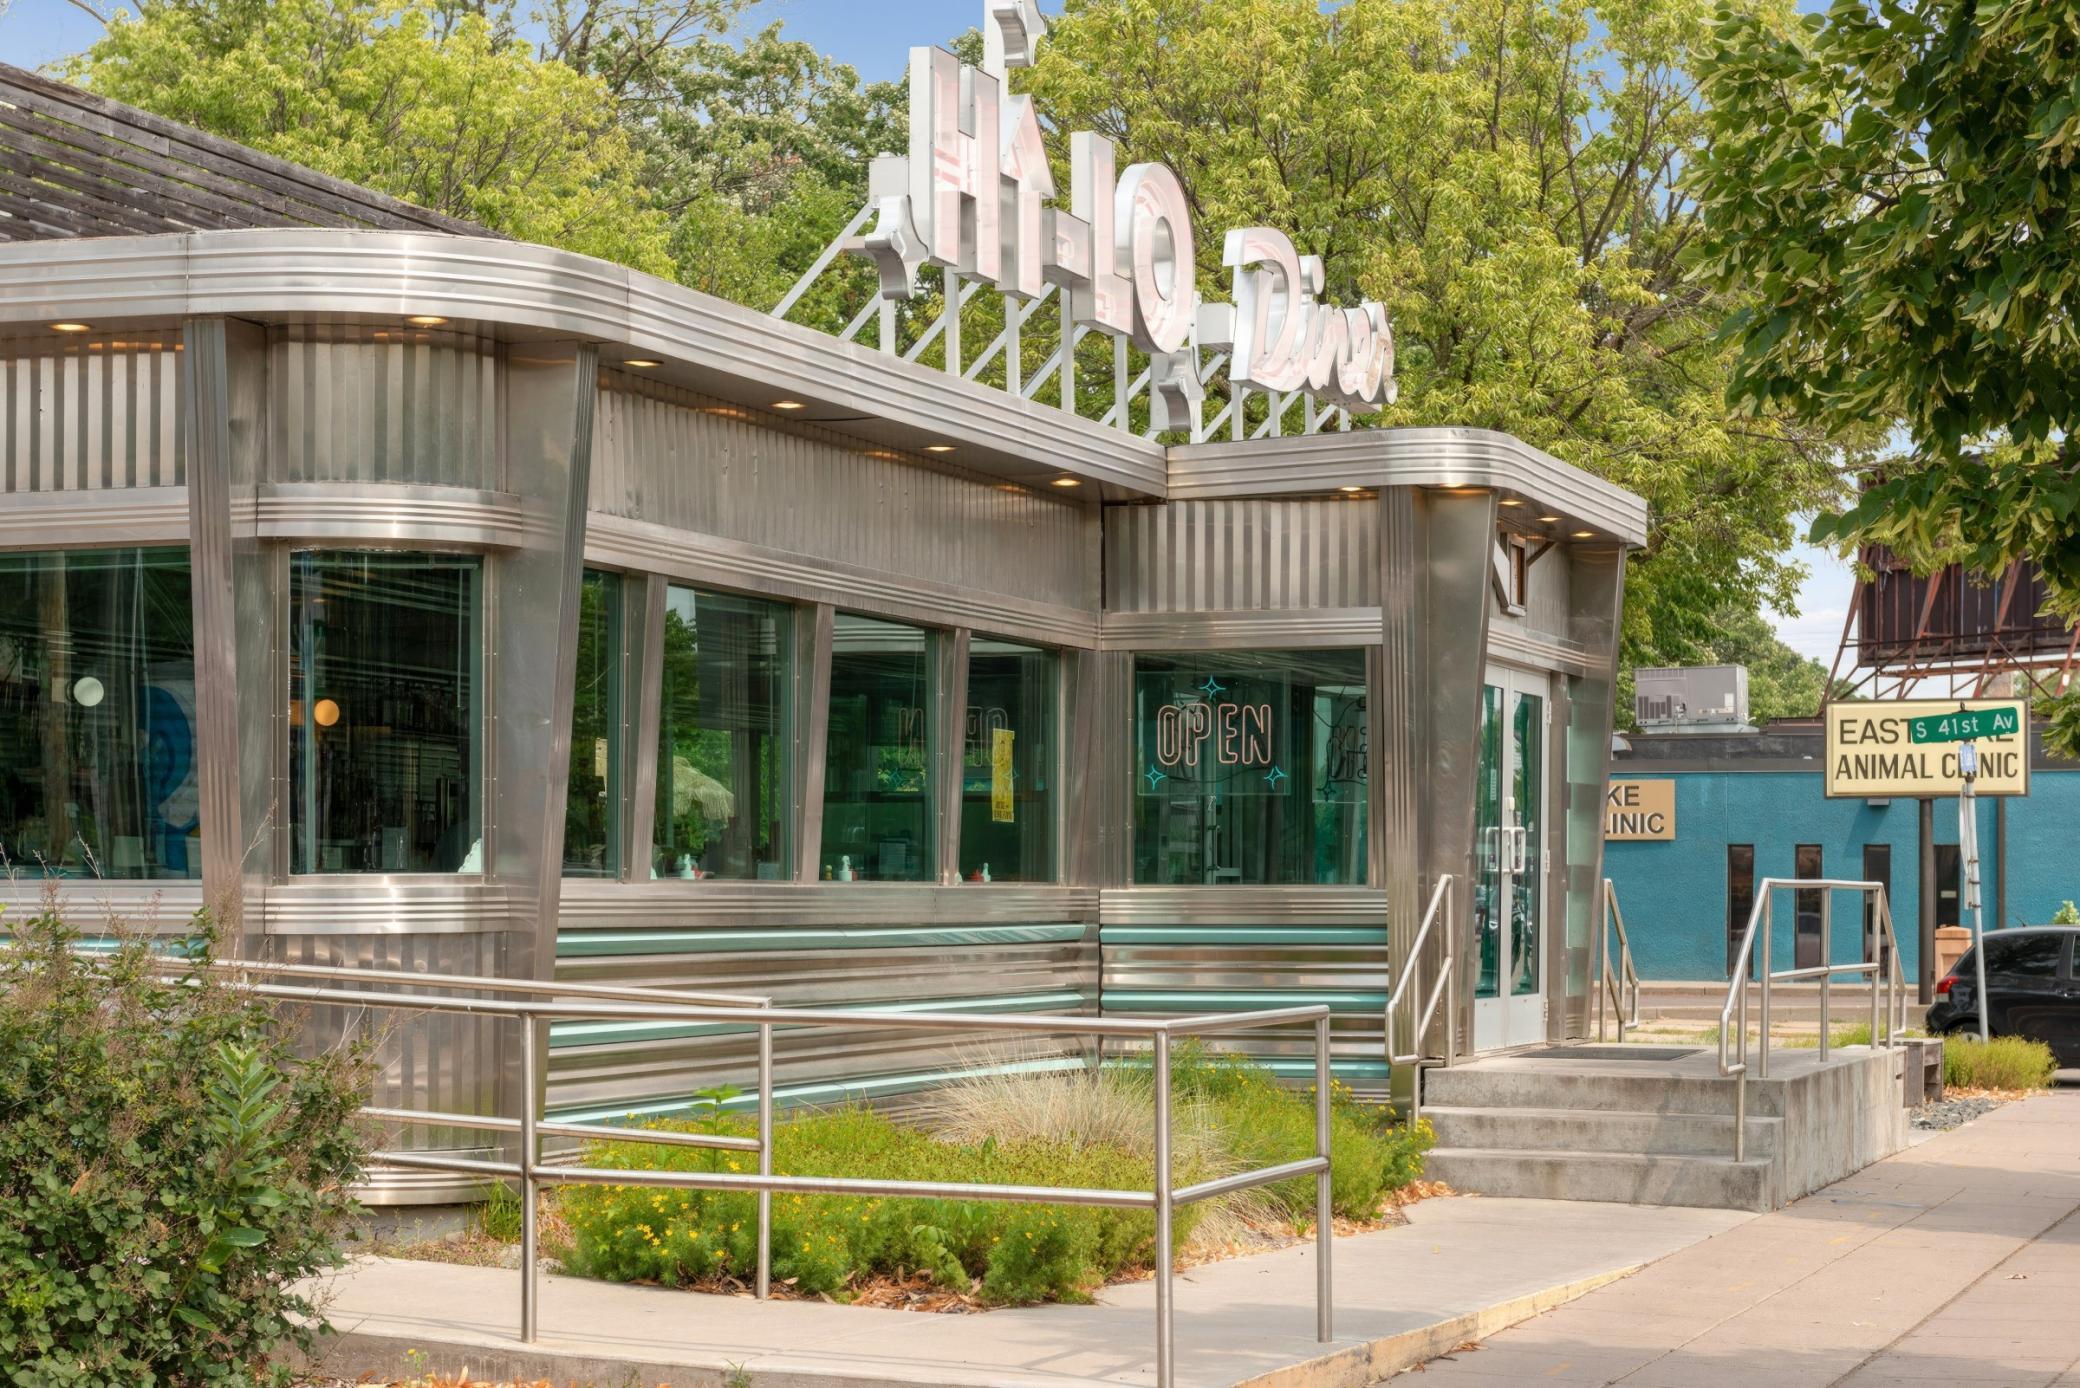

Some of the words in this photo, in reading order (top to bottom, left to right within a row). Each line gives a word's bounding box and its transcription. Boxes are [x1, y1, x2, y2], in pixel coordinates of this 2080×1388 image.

[1157, 703, 1272, 766] OPEN
[1915, 721, 1927, 739] S
[1938, 716, 1979, 735] 41st
[1993, 713, 2013, 730] Av
[1836, 753, 1933, 780] ANIMAL
[1942, 752, 2018, 779] CLNIC
[1605, 812, 1664, 834] INIC
